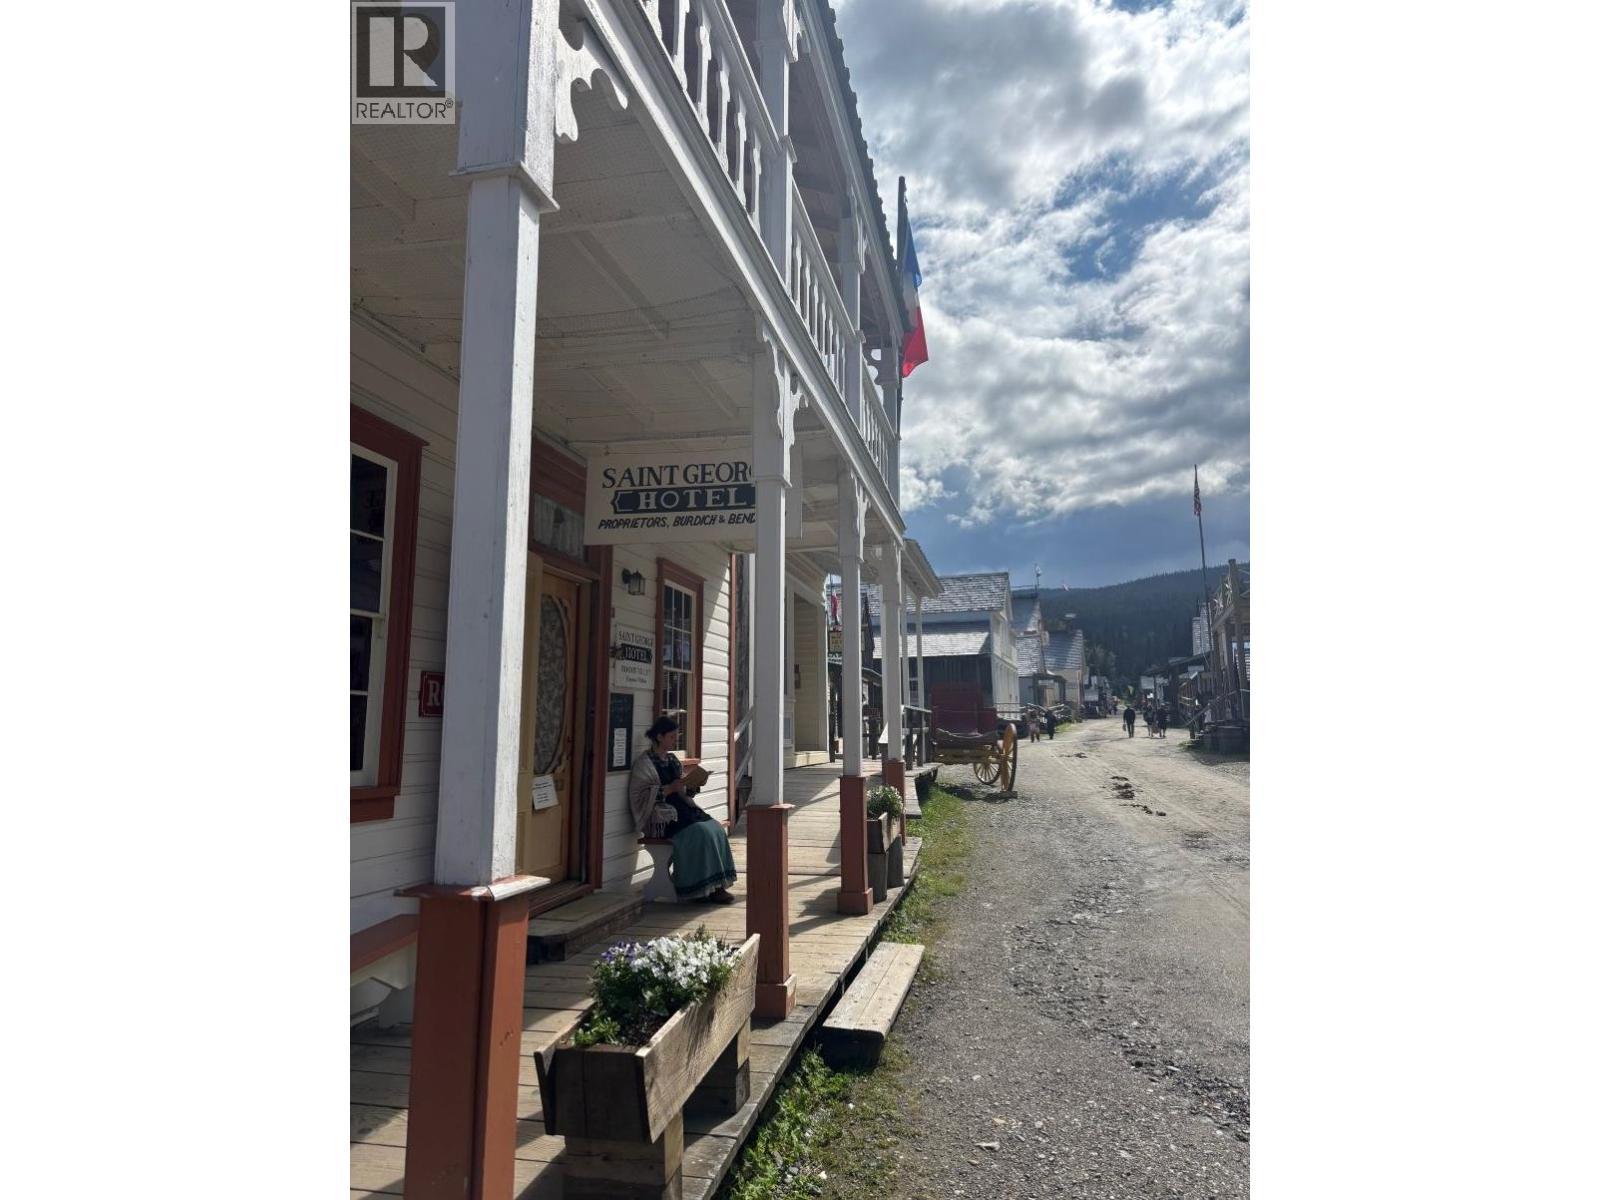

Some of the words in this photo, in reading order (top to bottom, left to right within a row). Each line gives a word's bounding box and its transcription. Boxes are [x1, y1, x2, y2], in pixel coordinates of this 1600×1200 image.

[602, 464, 680, 489] SAINT
[683, 461, 752, 485] GEOR
[636, 487, 747, 511] HOTEL
[718, 515, 726, 524] &
[625, 647, 648, 661] HOTEL
